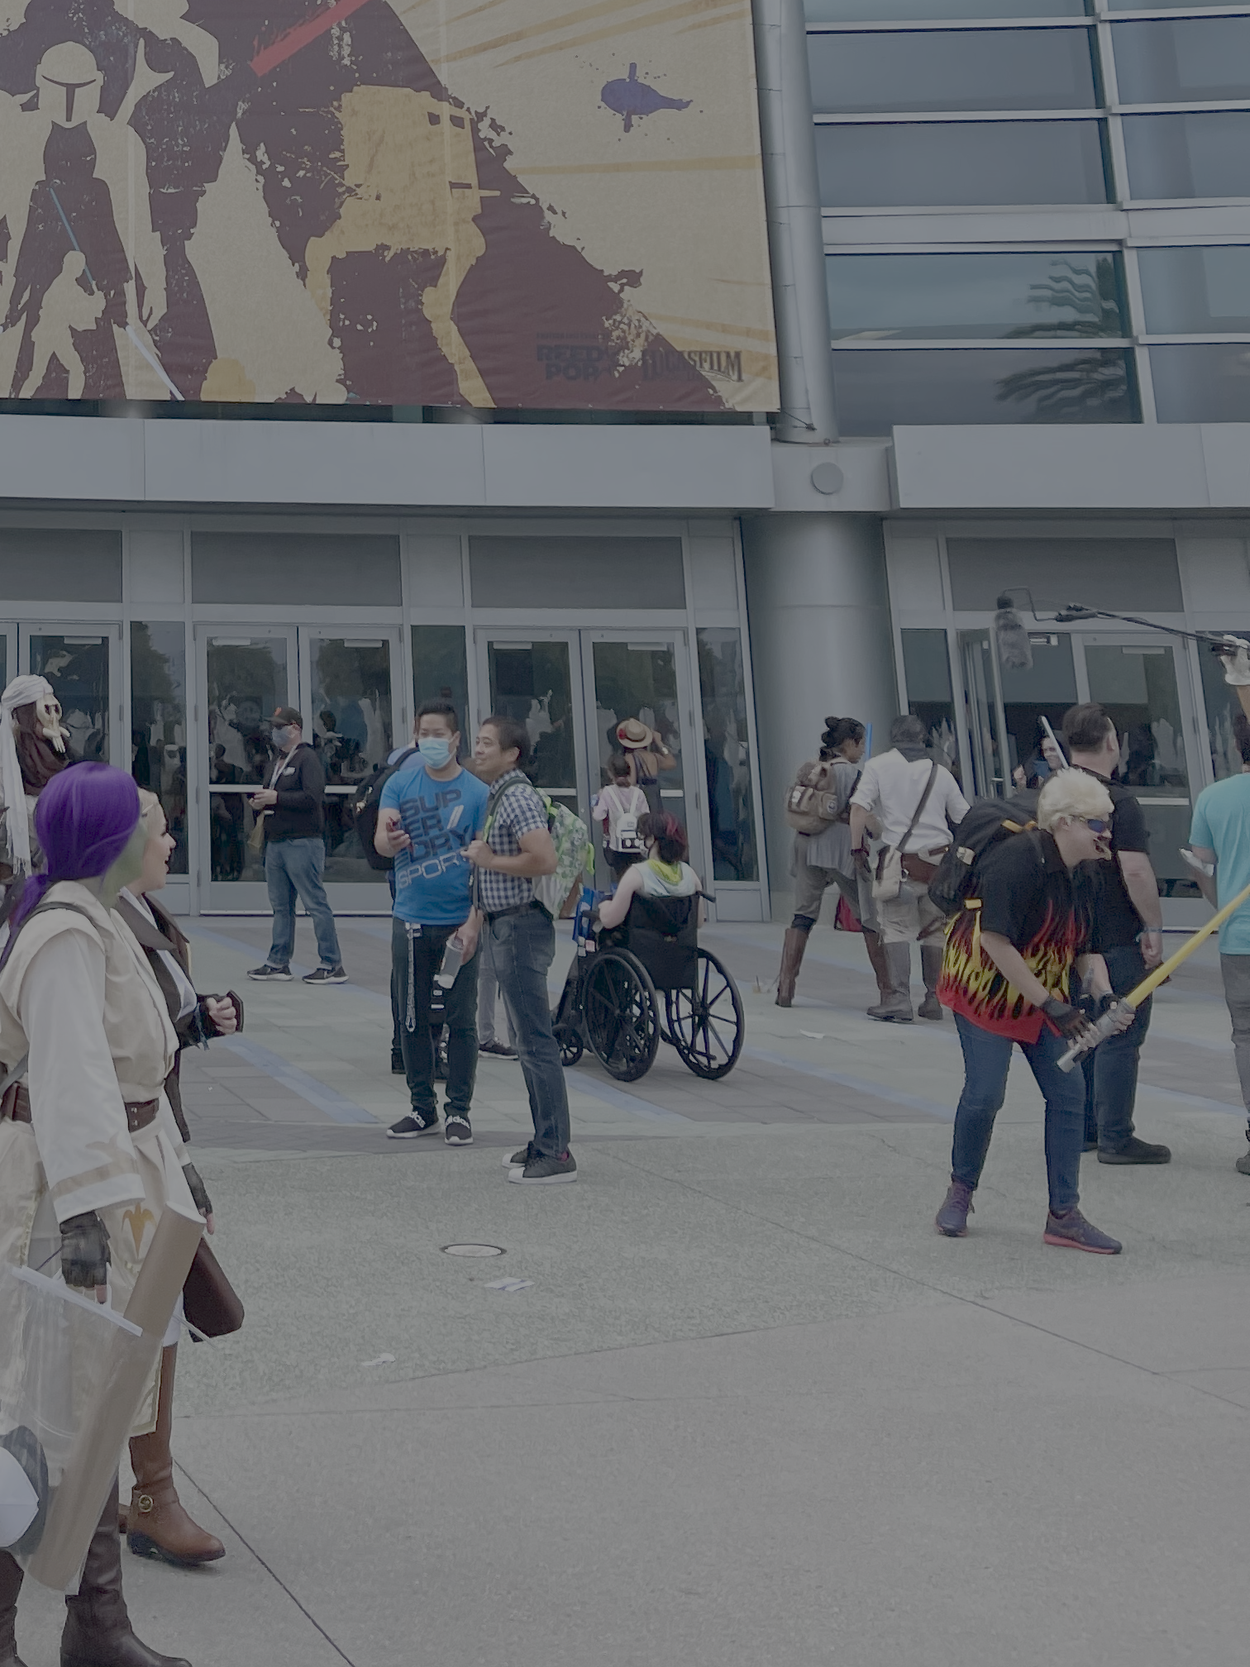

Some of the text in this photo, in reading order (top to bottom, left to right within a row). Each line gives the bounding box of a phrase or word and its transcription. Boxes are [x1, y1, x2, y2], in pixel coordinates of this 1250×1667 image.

[536, 344, 604, 362] REED
[546, 363, 599, 381] POP
[397, 851, 467, 889] SPOR
